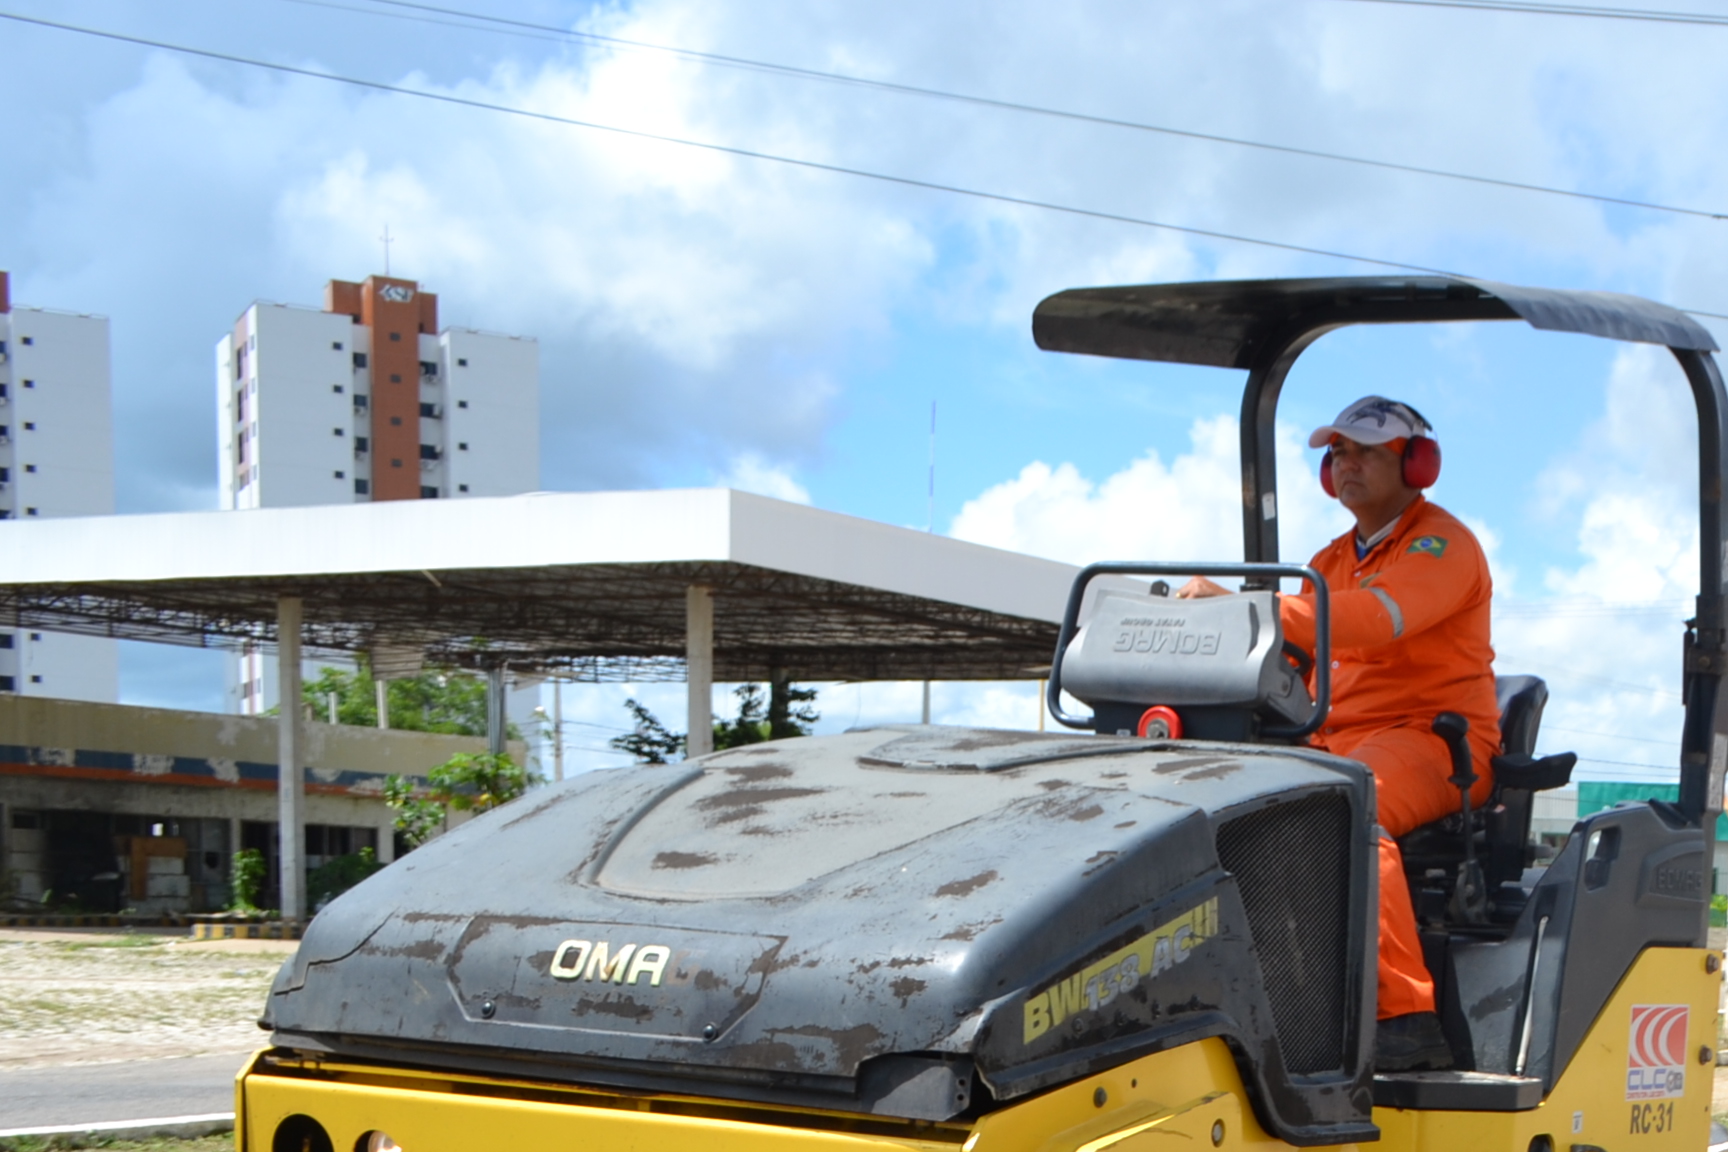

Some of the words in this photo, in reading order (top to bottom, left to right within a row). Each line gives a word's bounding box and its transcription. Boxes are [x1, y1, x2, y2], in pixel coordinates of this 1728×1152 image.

[1112, 629, 1222, 656] BOMAG
[1627, 1068, 1667, 1091] CLC
[1629, 1101, 1674, 1135] RC-31
